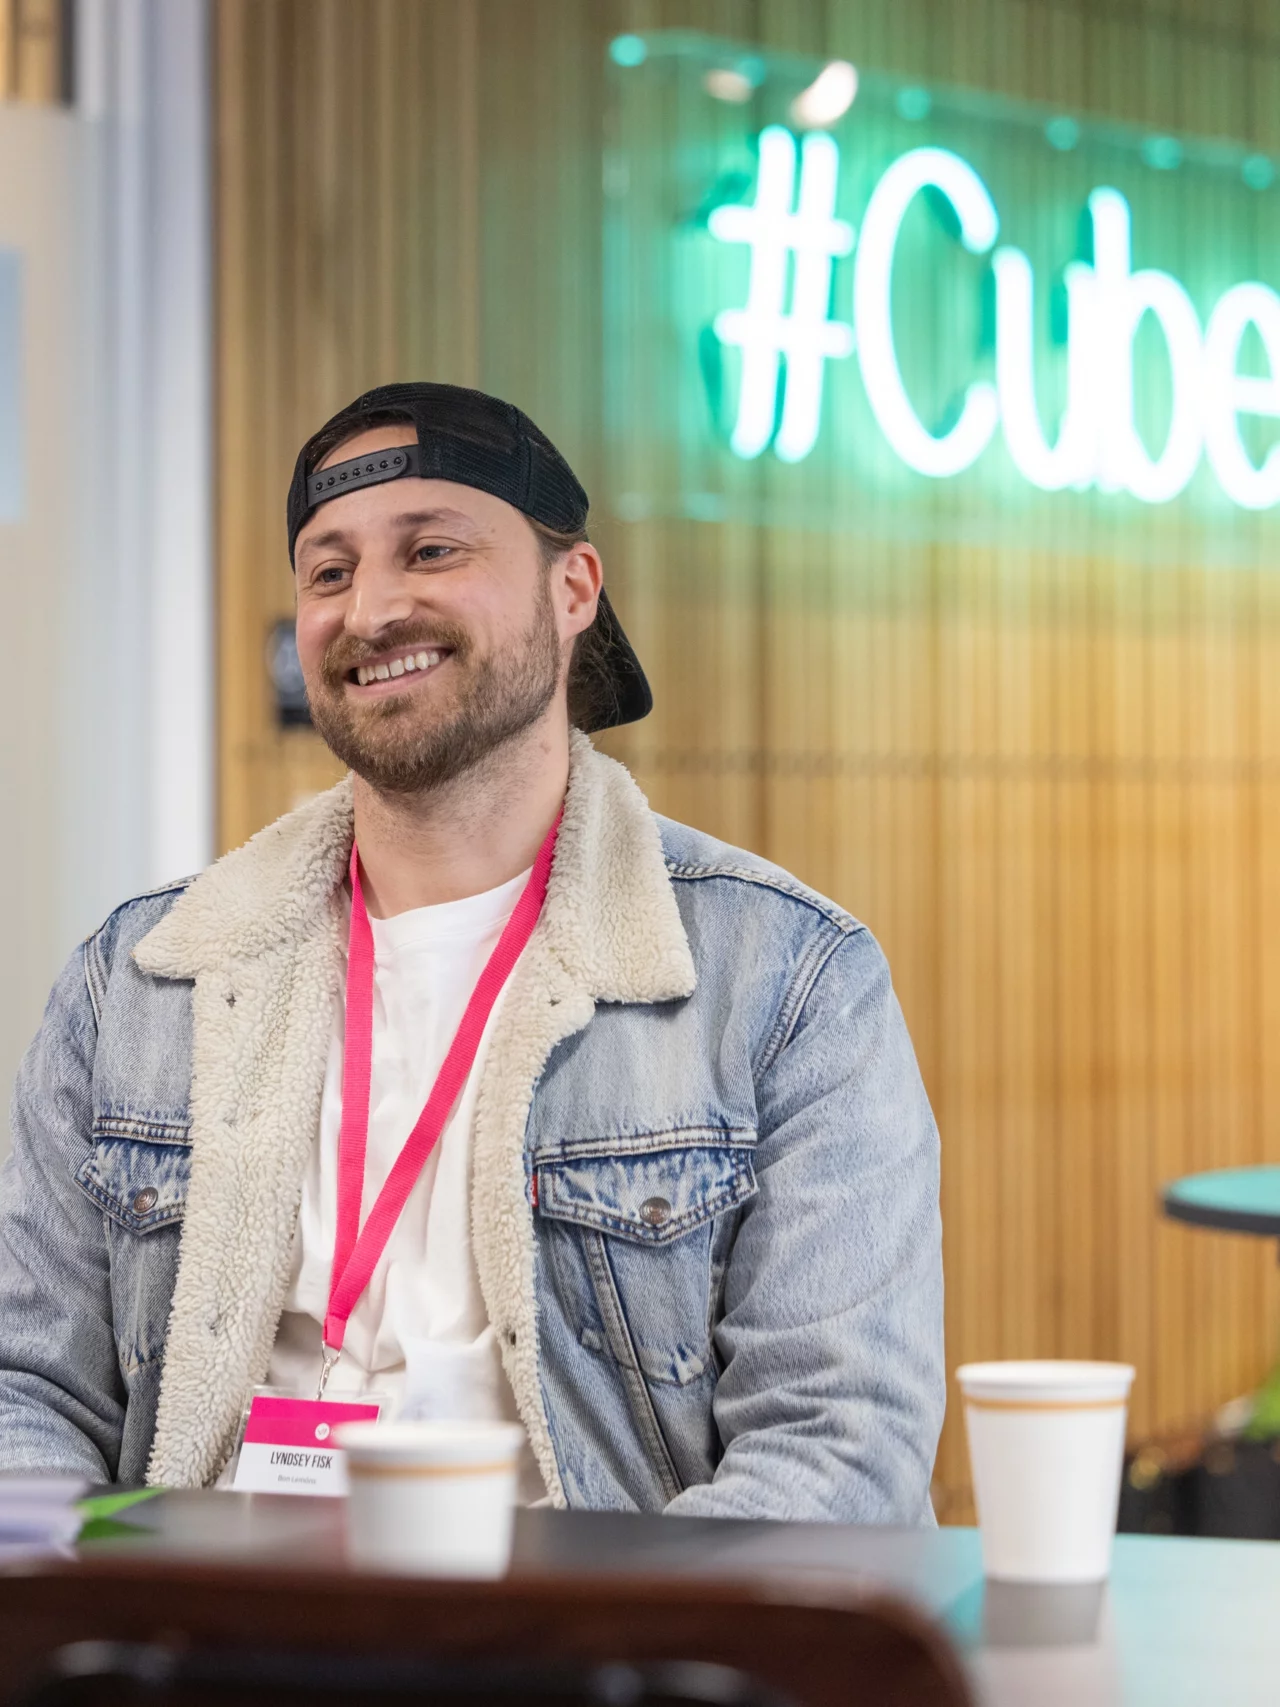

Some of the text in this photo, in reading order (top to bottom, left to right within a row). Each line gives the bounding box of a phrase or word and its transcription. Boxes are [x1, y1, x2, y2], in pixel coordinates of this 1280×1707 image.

[708, 124, 1280, 510] #Cube
[270, 1451, 333, 1469] LYNDSEY FISK
